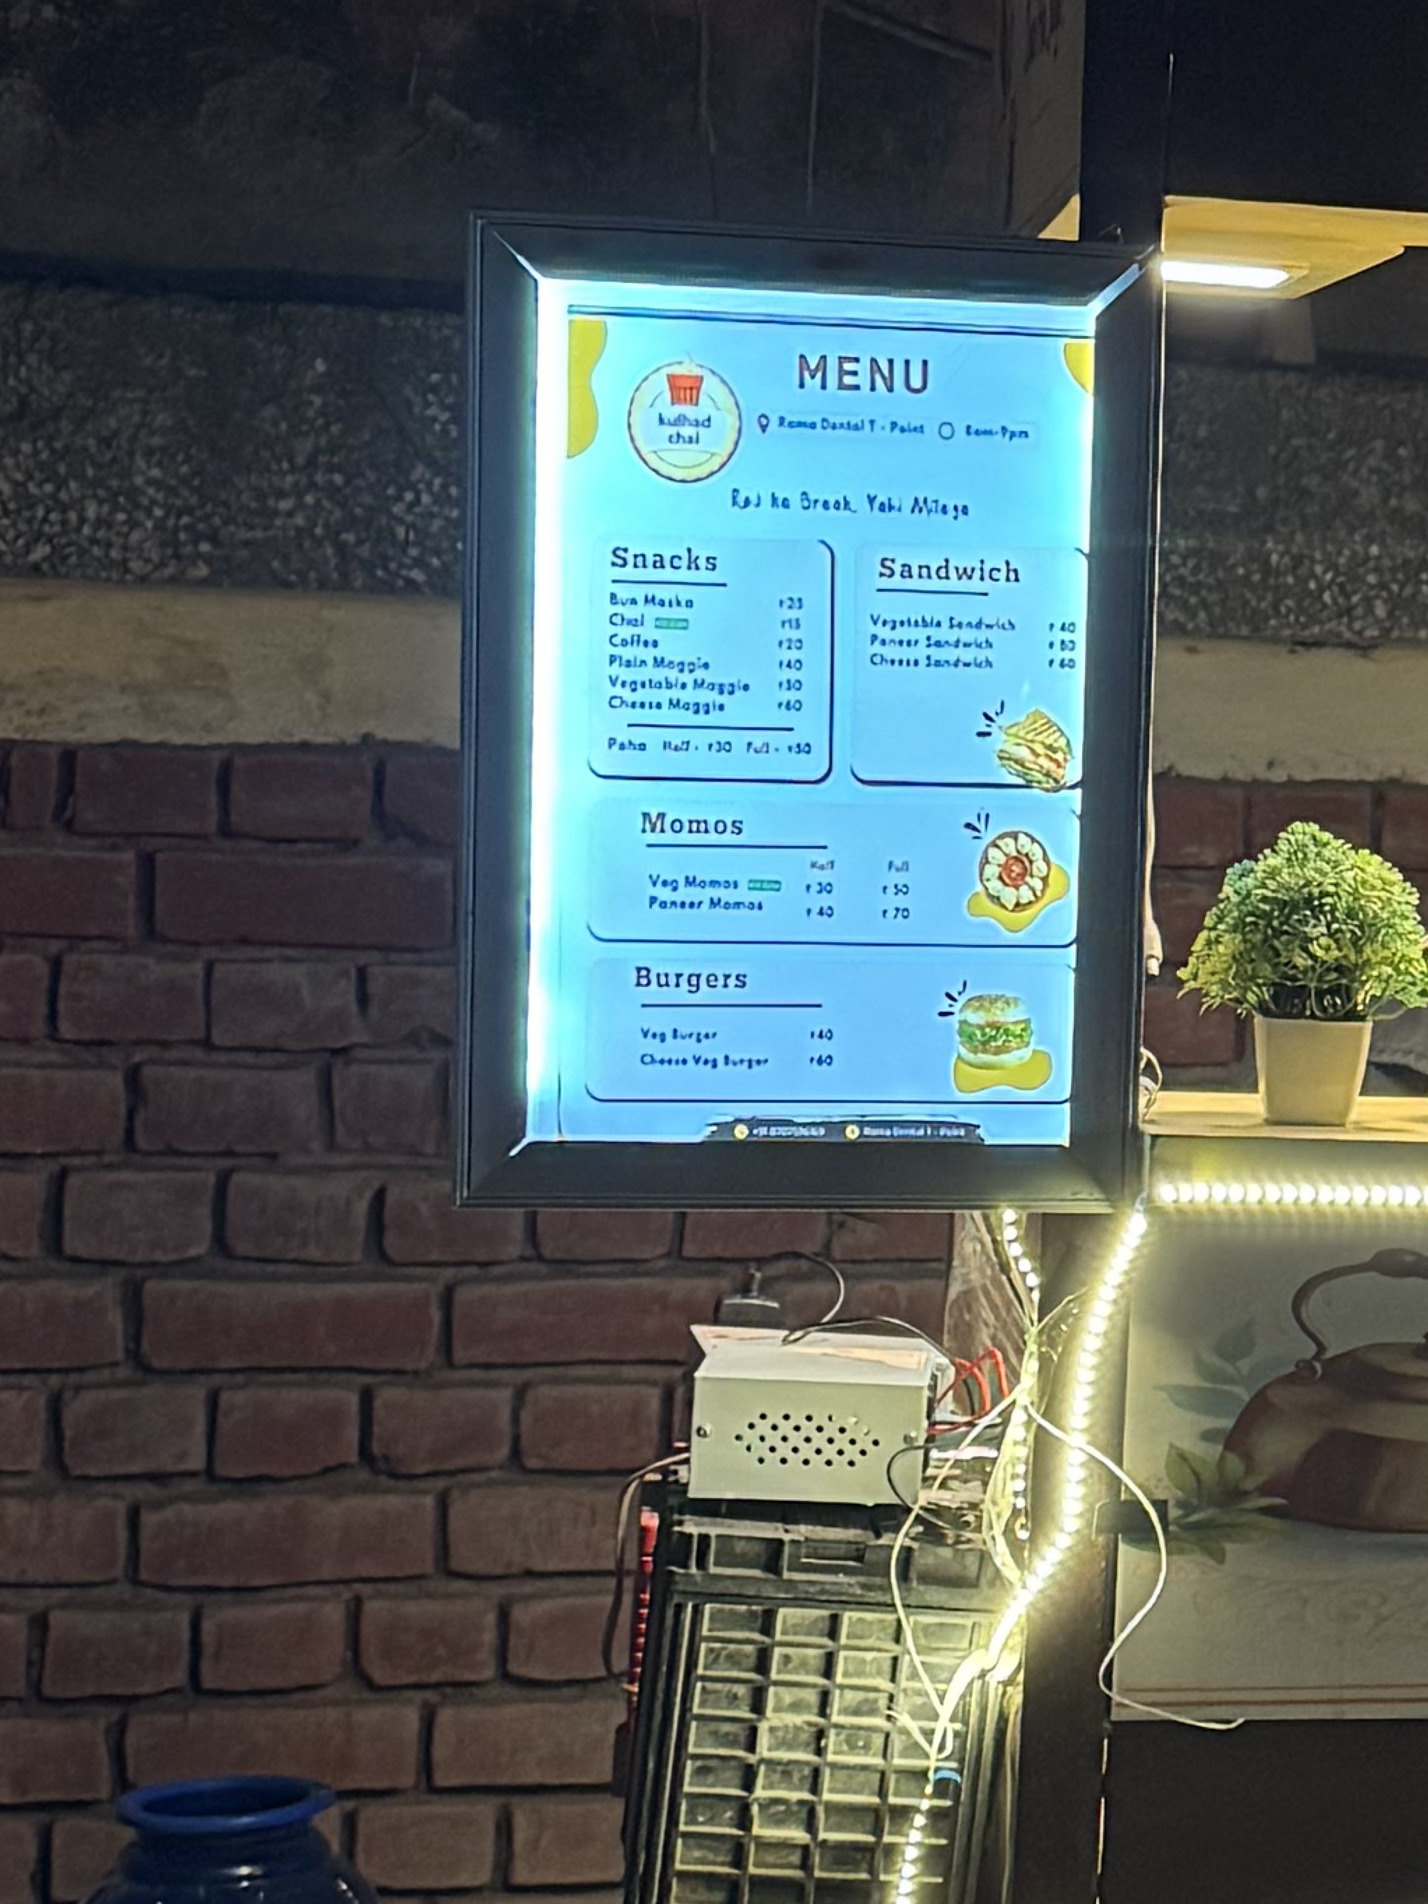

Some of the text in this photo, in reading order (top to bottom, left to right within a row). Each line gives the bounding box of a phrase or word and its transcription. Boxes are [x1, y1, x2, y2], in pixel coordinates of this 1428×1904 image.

[798, 354, 928, 394] MENU
[658, 412, 711, 428] kulhad
[611, 547, 718, 572] Snacks
[879, 557, 1020, 583] Sandwich
[609, 613, 644, 627] Chai
[948, 616, 1016, 631] Sandwich
[609, 634, 659, 648] Coffee
[925, 635, 993, 649] Sandwich
[609, 654, 647, 668] Plain
[925, 654, 993, 668] Sandwich
[641, 812, 744, 835] Momos
[649, 874, 679, 891] Veg
[684, 876, 739, 890] Momos
[649, 896, 763, 911] Paneer Momos
[634, 967, 748, 994] Burgers
[640, 1027, 666, 1043] Veg
[693, 1055, 718, 1069] Veg
